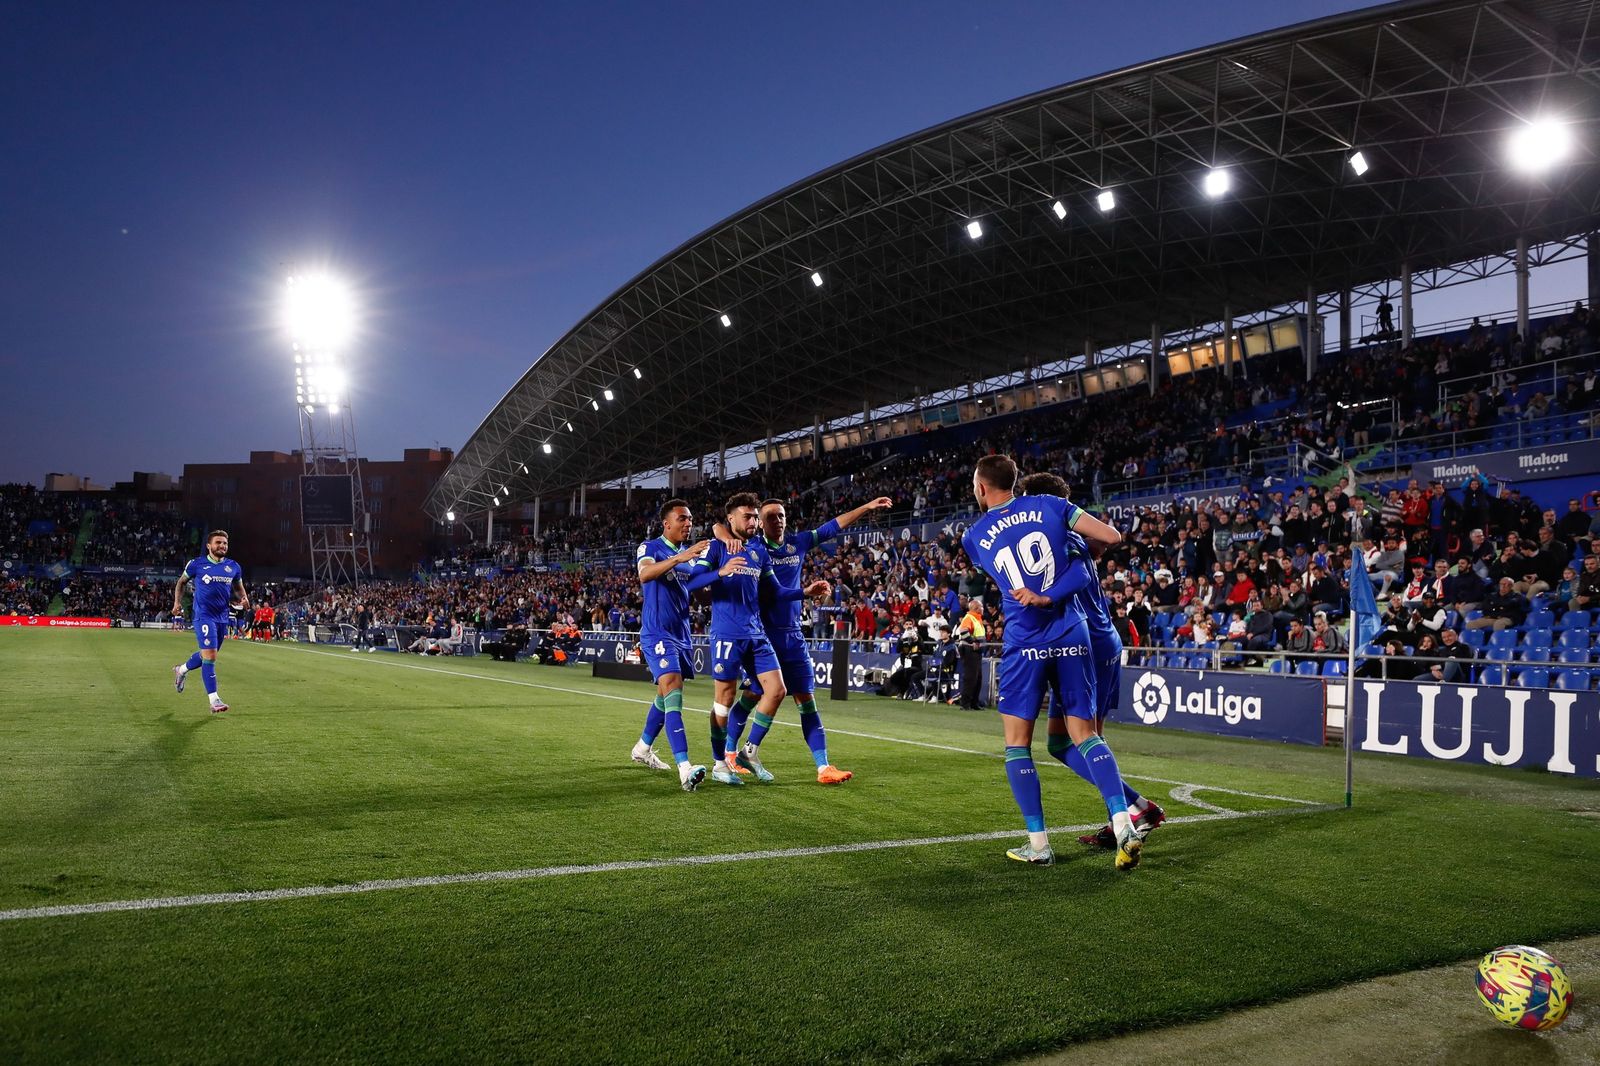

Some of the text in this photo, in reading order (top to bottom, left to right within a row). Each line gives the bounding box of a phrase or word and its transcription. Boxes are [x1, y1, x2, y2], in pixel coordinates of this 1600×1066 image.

[1518, 452, 1569, 468] Mahou
[1433, 464, 1477, 479] Mahou
[979, 510, 1044, 551] B.MAYORAL
[993, 531, 1056, 593] 19
[201, 624, 209, 637] 9
[654, 640, 666, 655] 4
[715, 640, 733, 660] 17
[1175, 686, 1262, 725] LaLiga
[1361, 682, 1600, 774] LUJI
